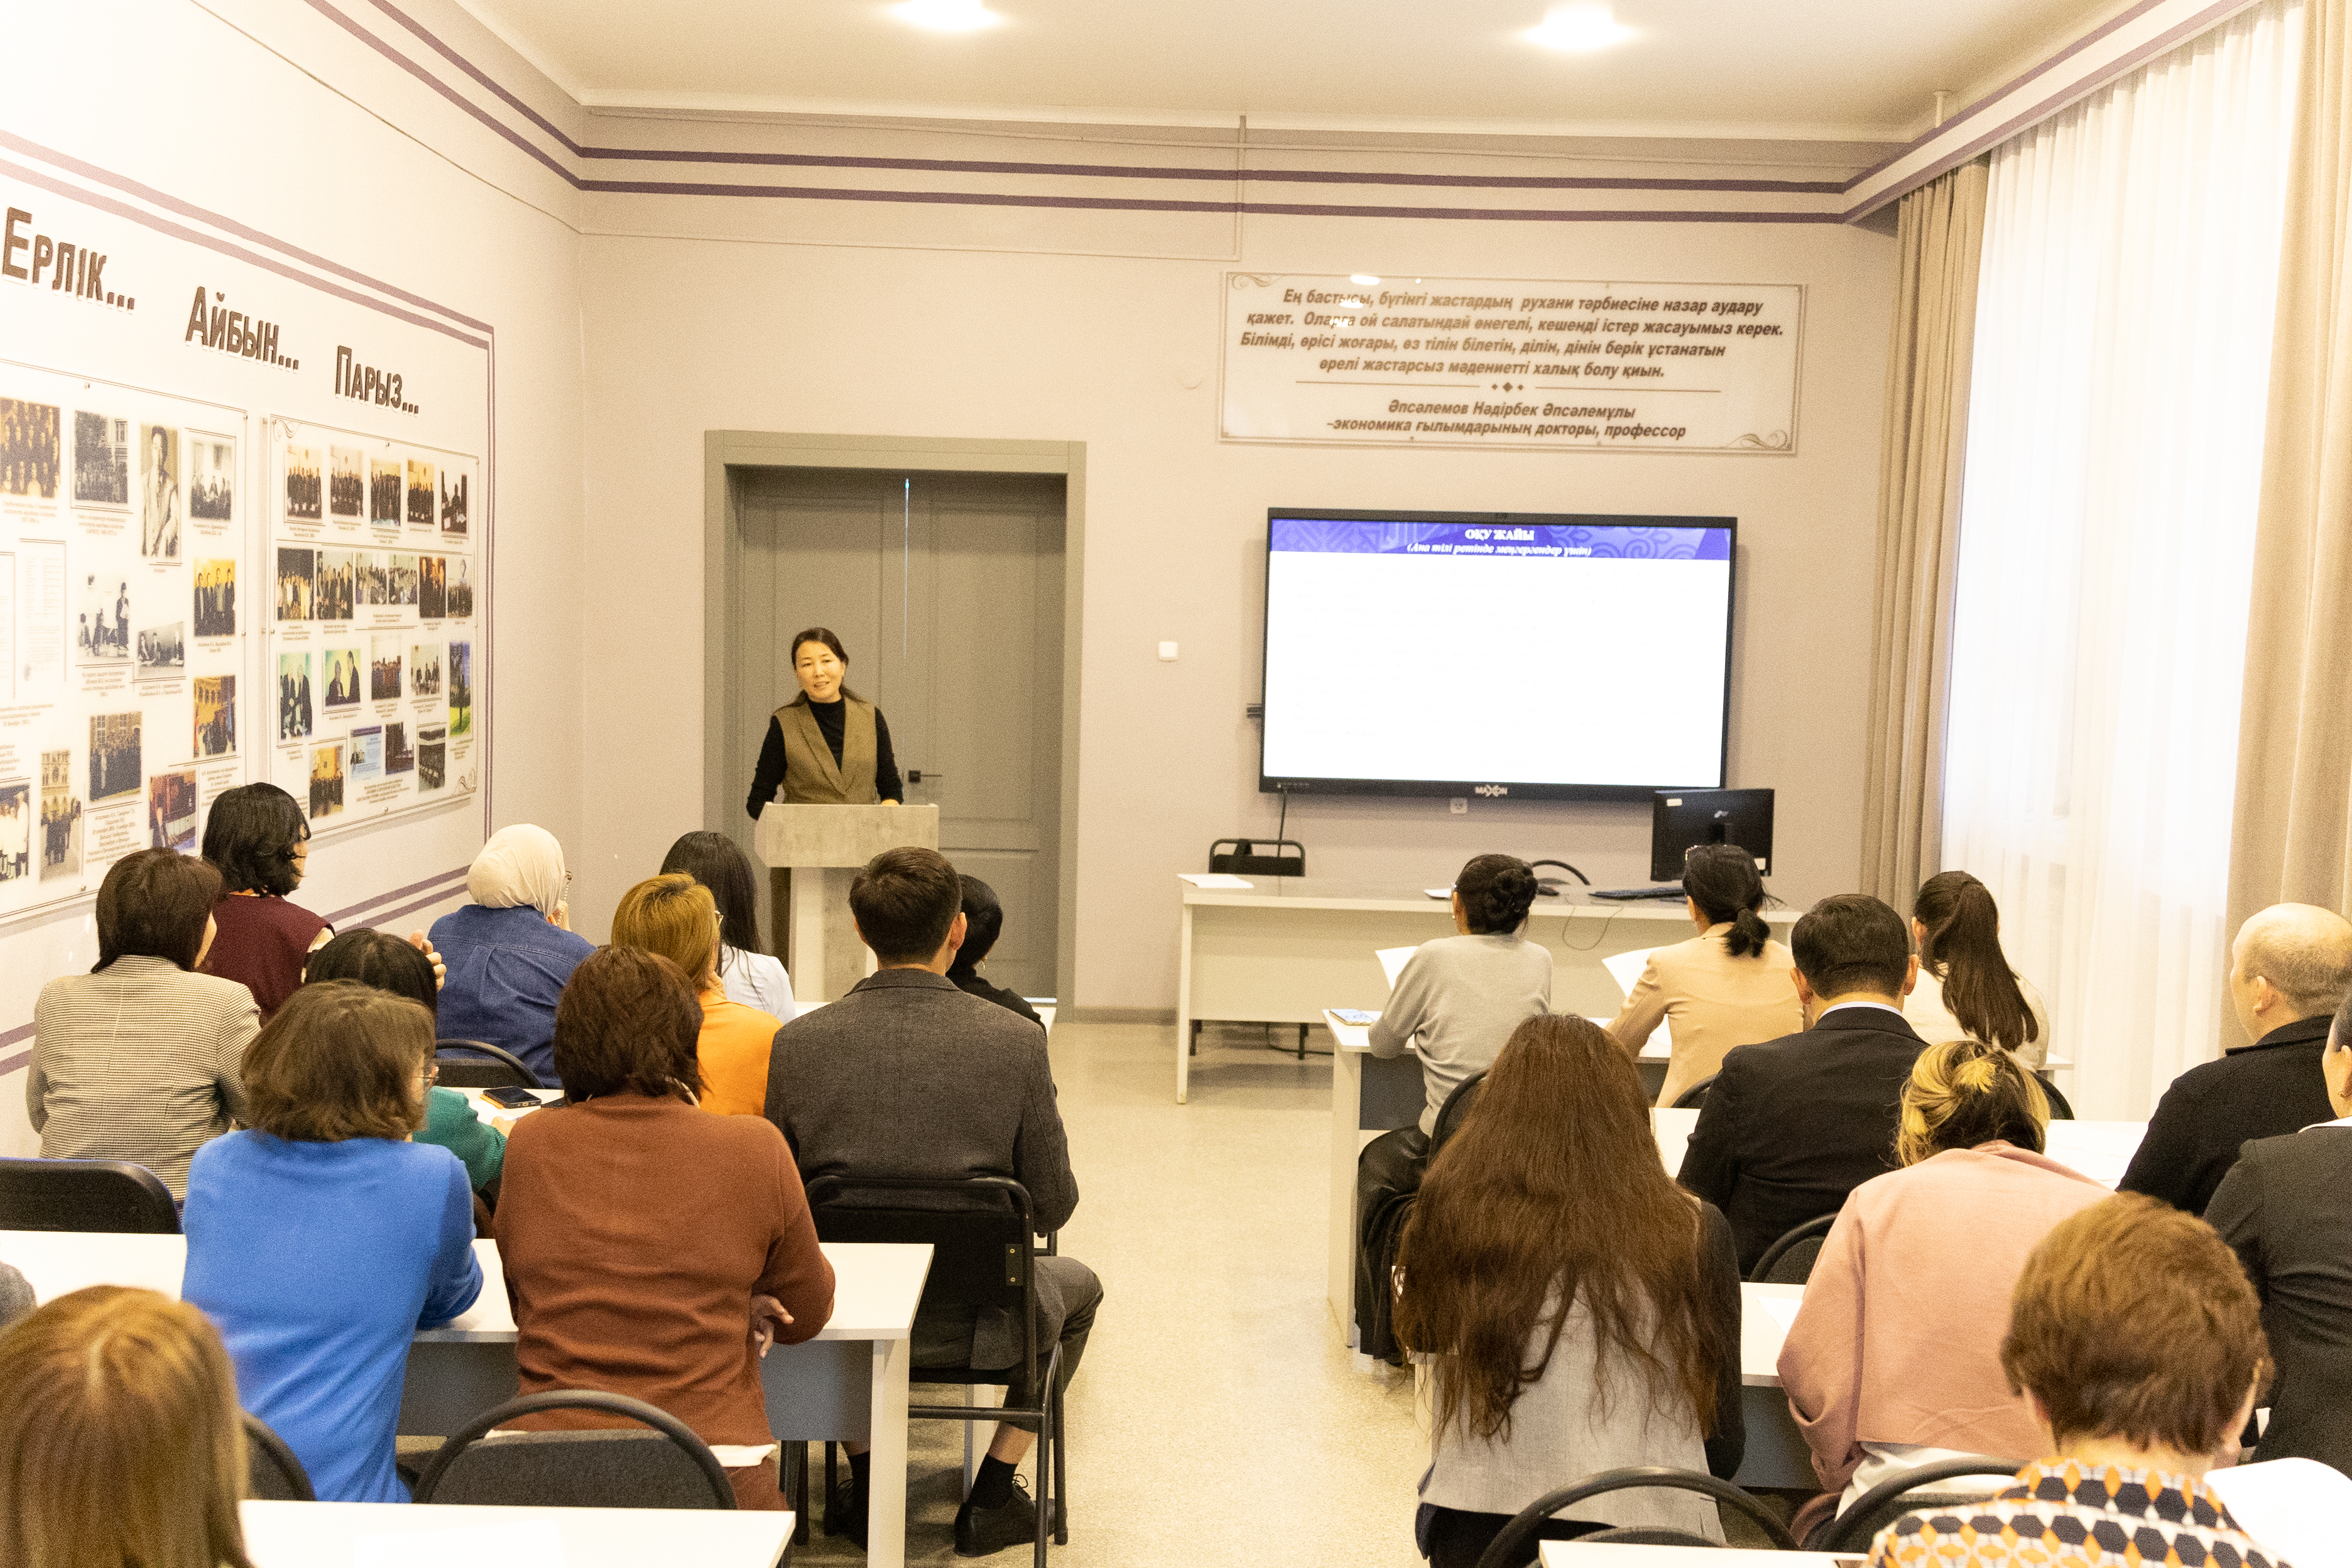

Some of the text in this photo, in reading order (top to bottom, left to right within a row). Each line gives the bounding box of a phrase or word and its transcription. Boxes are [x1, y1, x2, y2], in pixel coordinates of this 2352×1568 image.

[1283, 289, 1763, 316] Ең бастысы, бүгінгі жастардың рухани тәрбиесіне назар аудару
[1247, 313, 1294, 327] қажет.
[1359, 314, 1377, 327] ой
[1382, 315, 1471, 330] салатындай
[1474, 317, 1533, 333] өнегелі,
[1538, 318, 1599, 334] кешенді
[1602, 318, 1639, 334] істер
[1643, 321, 1732, 337] жасауымыз
[1736, 323, 1783, 337] керек.
[1241, 332, 1726, 357] Білімді, өрісі жоғары, өз тілін білетін, ділін, дінін берік ұстанатын
[1319, 357, 1359, 373] өрелі
[1362, 360, 1444, 375] жастарсыз
[1533, 364, 1580, 378] халық
[1584, 362, 1618, 378] болу
[1623, 366, 1664, 378] қиын.
[1535, 423, 1599, 437] докторы,
[1604, 422, 1686, 440] профессор
